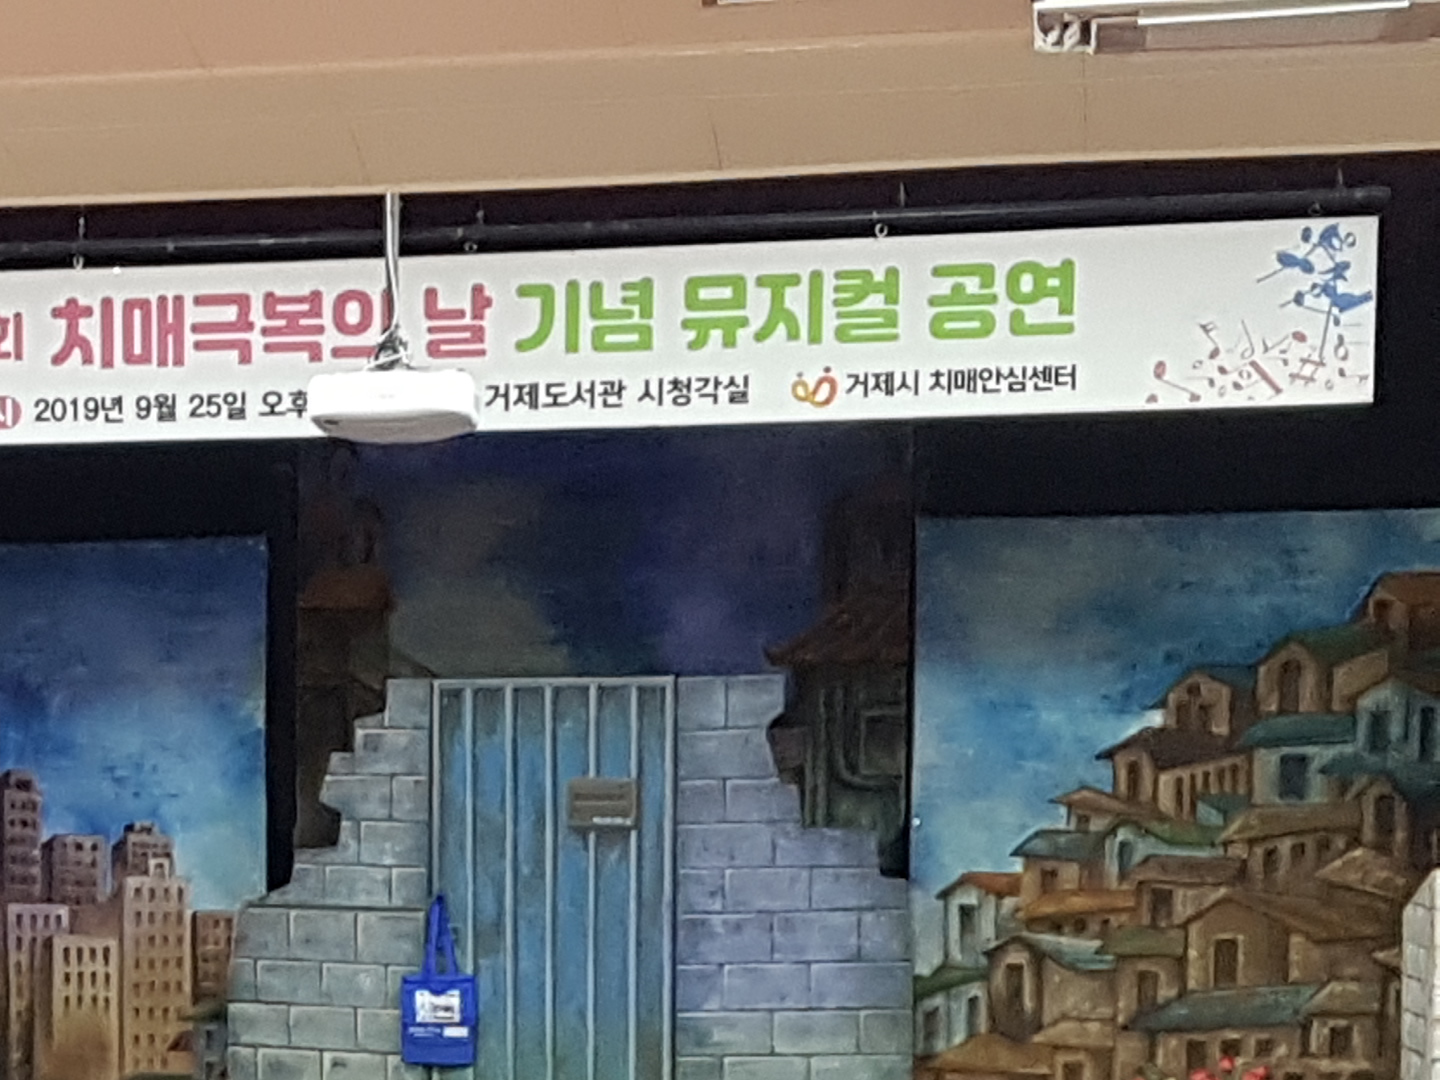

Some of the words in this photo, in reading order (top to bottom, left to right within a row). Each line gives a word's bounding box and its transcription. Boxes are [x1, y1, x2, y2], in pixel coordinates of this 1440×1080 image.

[50, 288, 398, 369] 치매극복의
[424, 282, 493, 359] 날
[515, 276, 655, 354] 기념
[681, 265, 901, 351] 뮤지컬
[927, 258, 1077, 340] 공연
[484, 379, 627, 412] 거제도서관
[637, 374, 751, 407] 시청각실
[845, 369, 920, 398] 거제시
[928, 363, 1078, 395] 치매안심센터
[34, 396, 124, 424] 2019년
[135, 392, 177, 423] 9월
[188, 391, 247, 421] 25일
[258, 389, 308, 419] 오후
